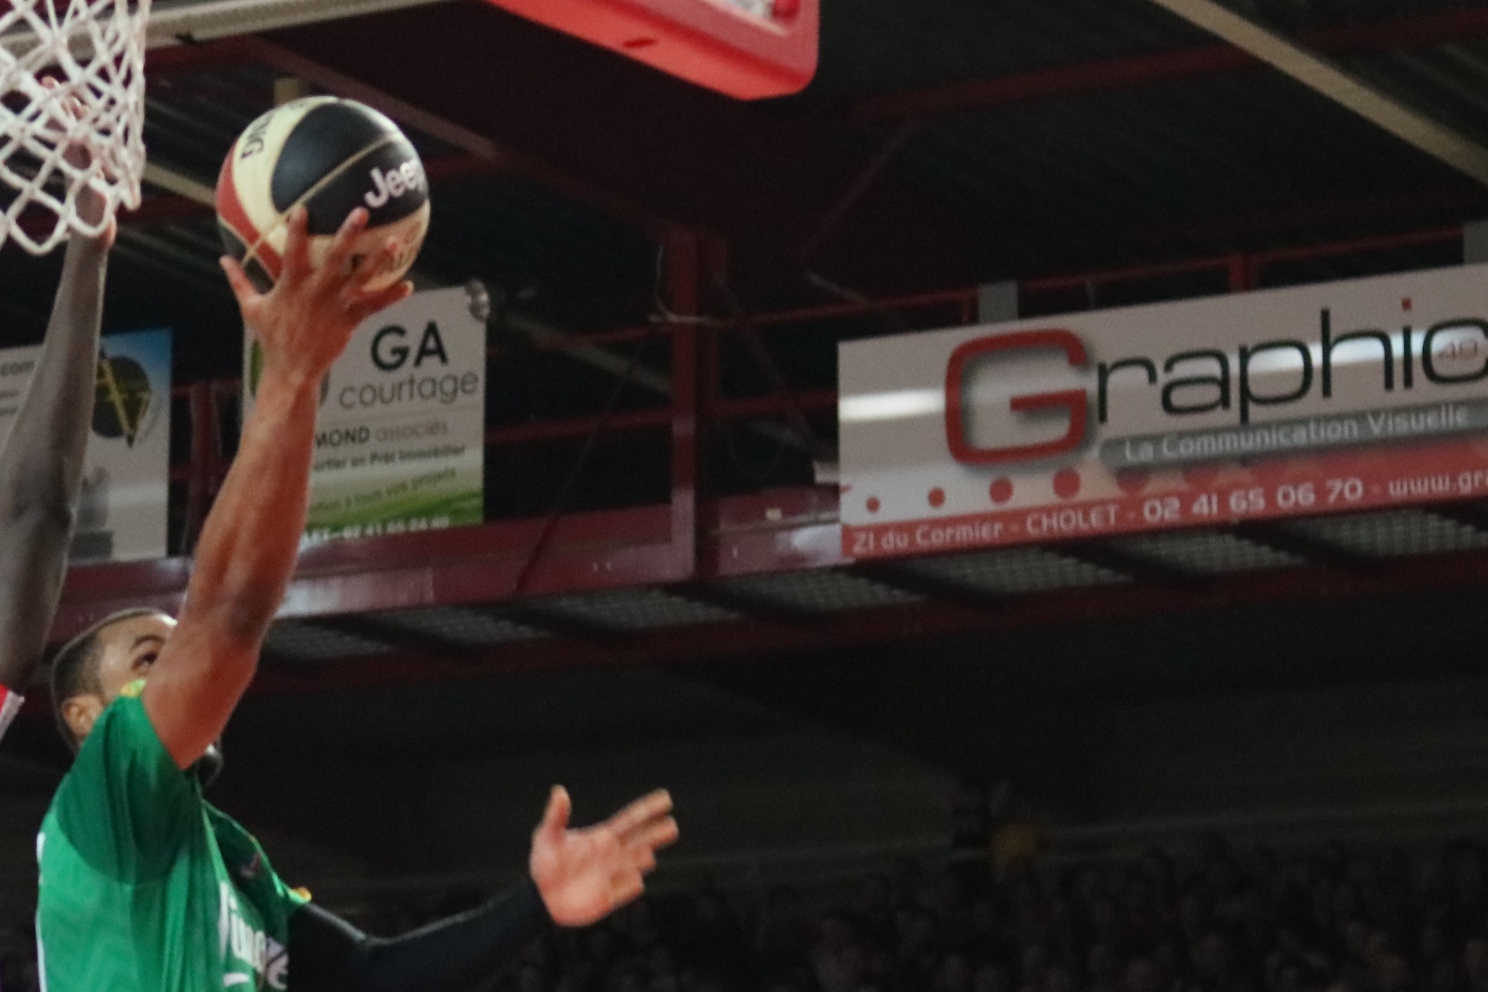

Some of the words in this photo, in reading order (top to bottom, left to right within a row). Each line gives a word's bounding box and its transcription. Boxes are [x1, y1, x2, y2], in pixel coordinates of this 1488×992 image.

[371, 320, 448, 373] GA
[339, 372, 479, 410] courtage
[1162, 419, 1359, 459] Communication
[1367, 402, 1470, 437] Visuelle
[881, 529, 909, 549] du
[914, 521, 1004, 546] Cormier
[1025, 503, 1120, 537] CHOLET
[1142, 498, 1181, 522] 02
[1276, 482, 1316, 507] 06
[1325, 478, 1363, 501] 70
